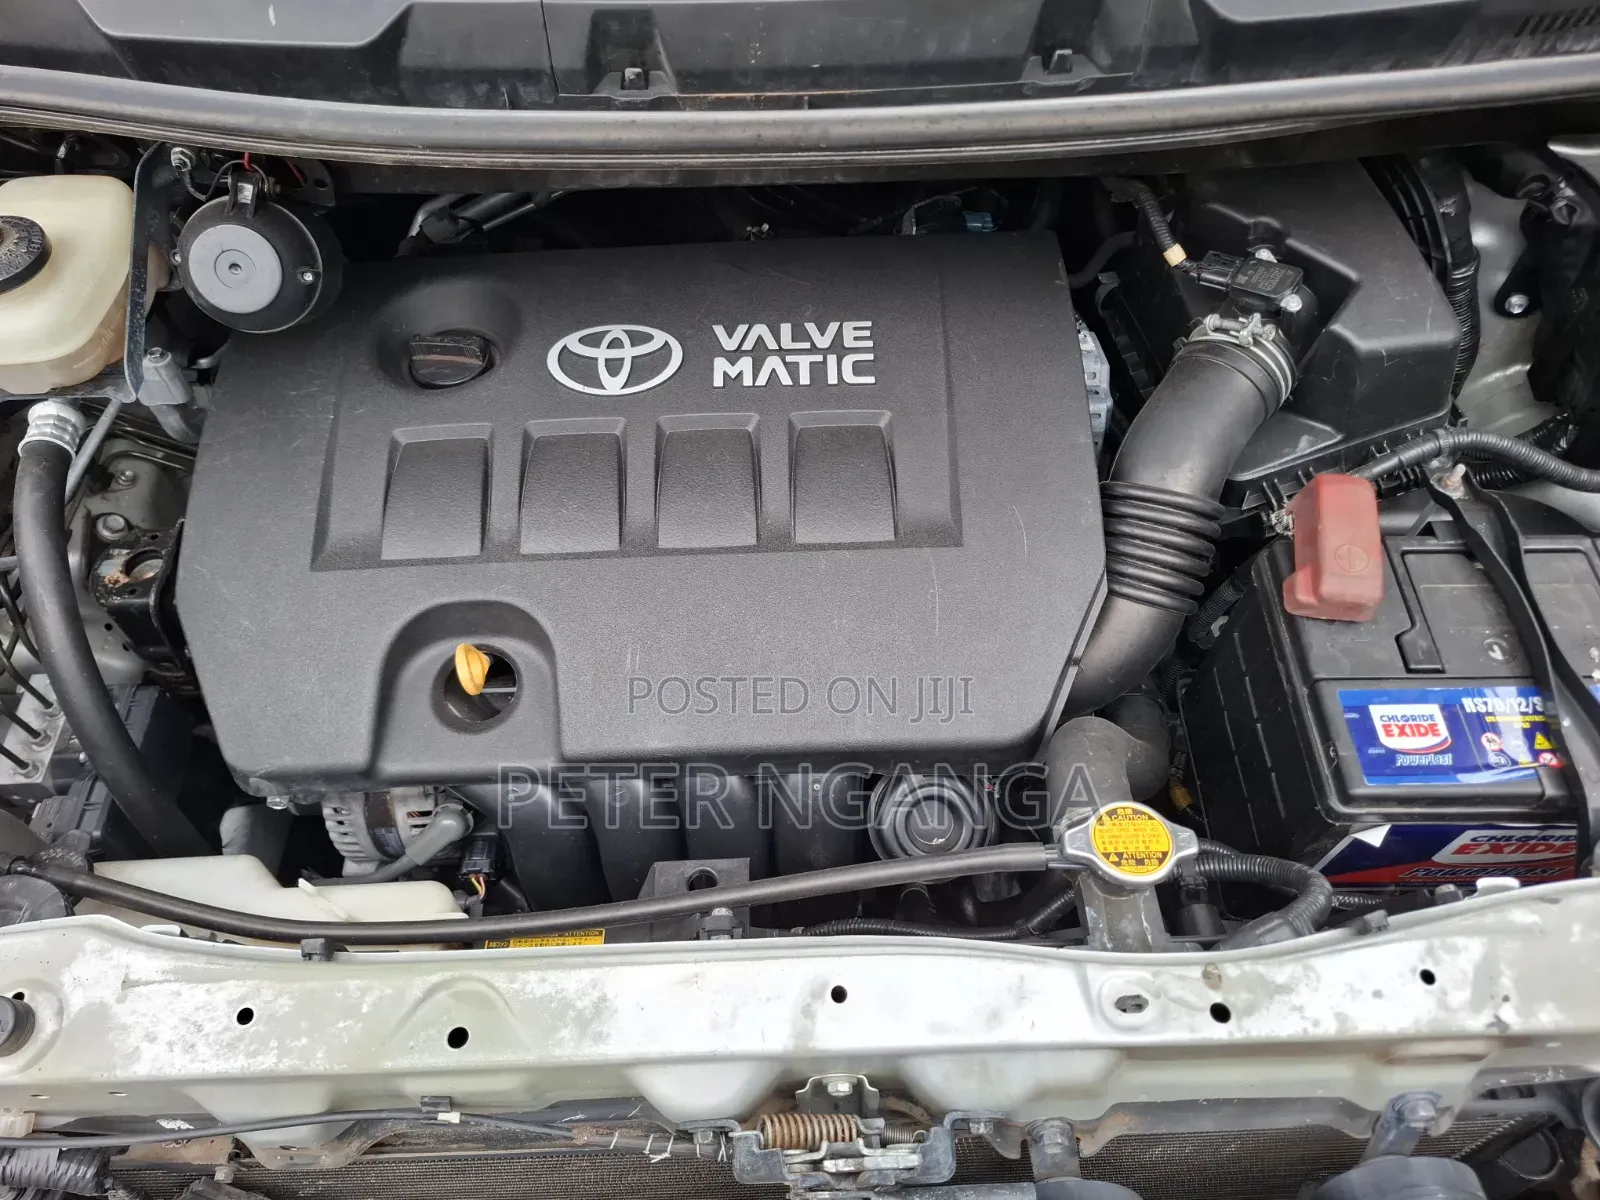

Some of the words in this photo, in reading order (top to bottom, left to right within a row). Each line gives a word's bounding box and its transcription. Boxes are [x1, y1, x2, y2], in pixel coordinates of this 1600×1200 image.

[712, 321, 874, 350] VALVE
[713, 353, 876, 387] MATIC
[1380, 714, 1436, 722] CHLORIDE
[1381, 723, 1442, 737] EXIDE
[1470, 834, 1577, 843] CHLORID
[1122, 851, 1163, 859] ATTENTION
[1450, 842, 1577, 855] EXIDE
